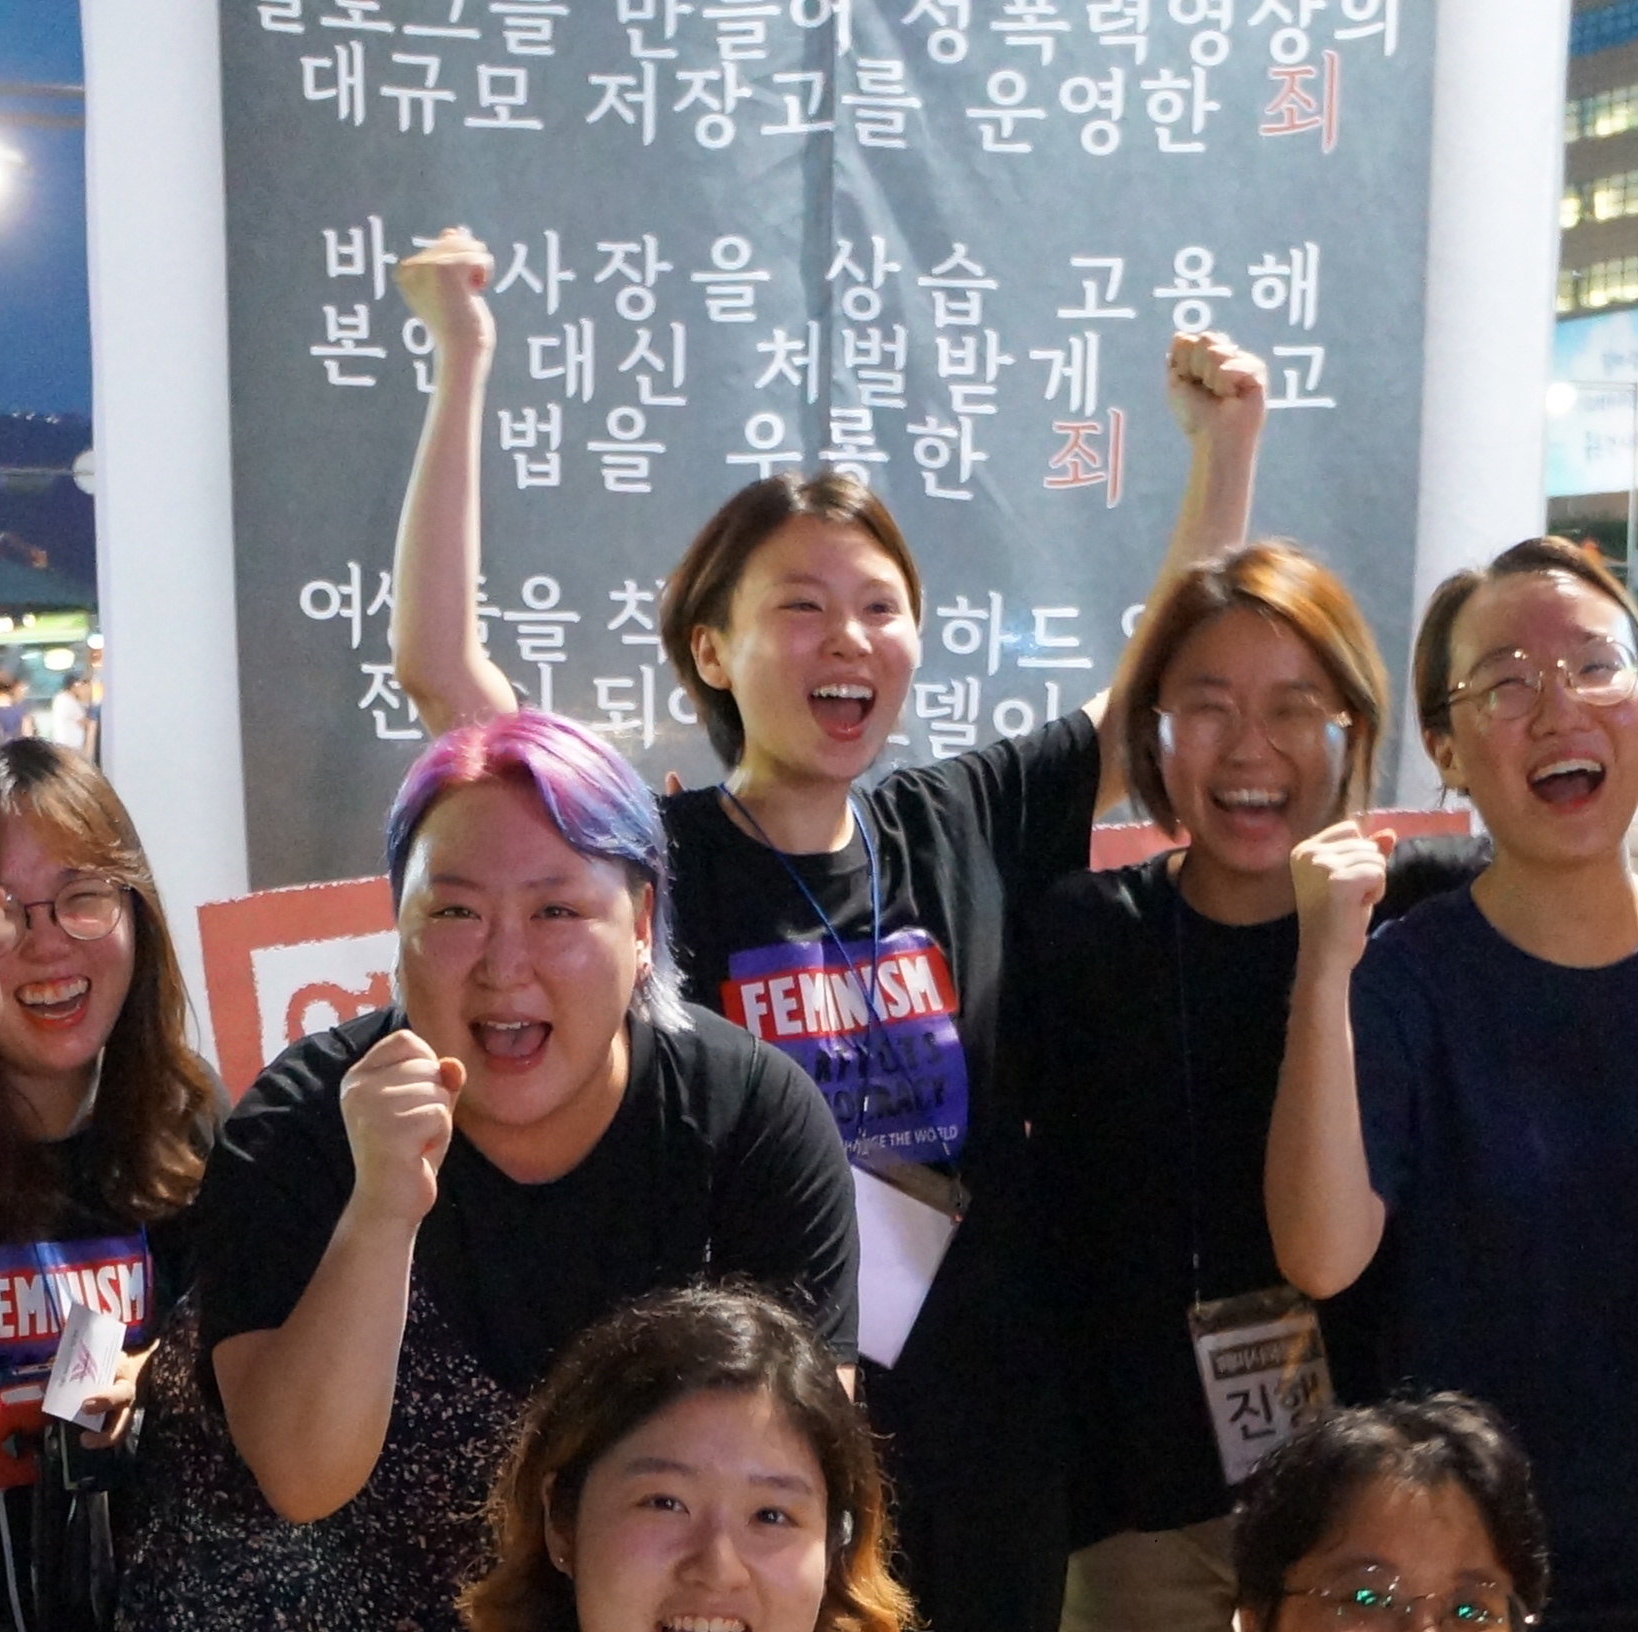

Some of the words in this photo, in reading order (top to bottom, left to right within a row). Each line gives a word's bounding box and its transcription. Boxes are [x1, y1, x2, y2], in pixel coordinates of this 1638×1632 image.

[300, 40, 545, 135] 대규모
[585, 58, 923, 150] 저장고를
[965, 65, 1221, 156] 운영한
[1259, 49, 1341, 155] 죄
[321, 214, 771, 324] 바사장을
[826, 235, 1000, 329] 상습
[1056, 241, 1321, 335] 고용해
[526, 317, 689, 406] 대신
[754, 319, 1103, 418] 처벌받게
[496, 402, 666, 493] 법을
[1042, 407, 1127, 510] 죄
[740, 954, 944, 1038] FEMINISM
